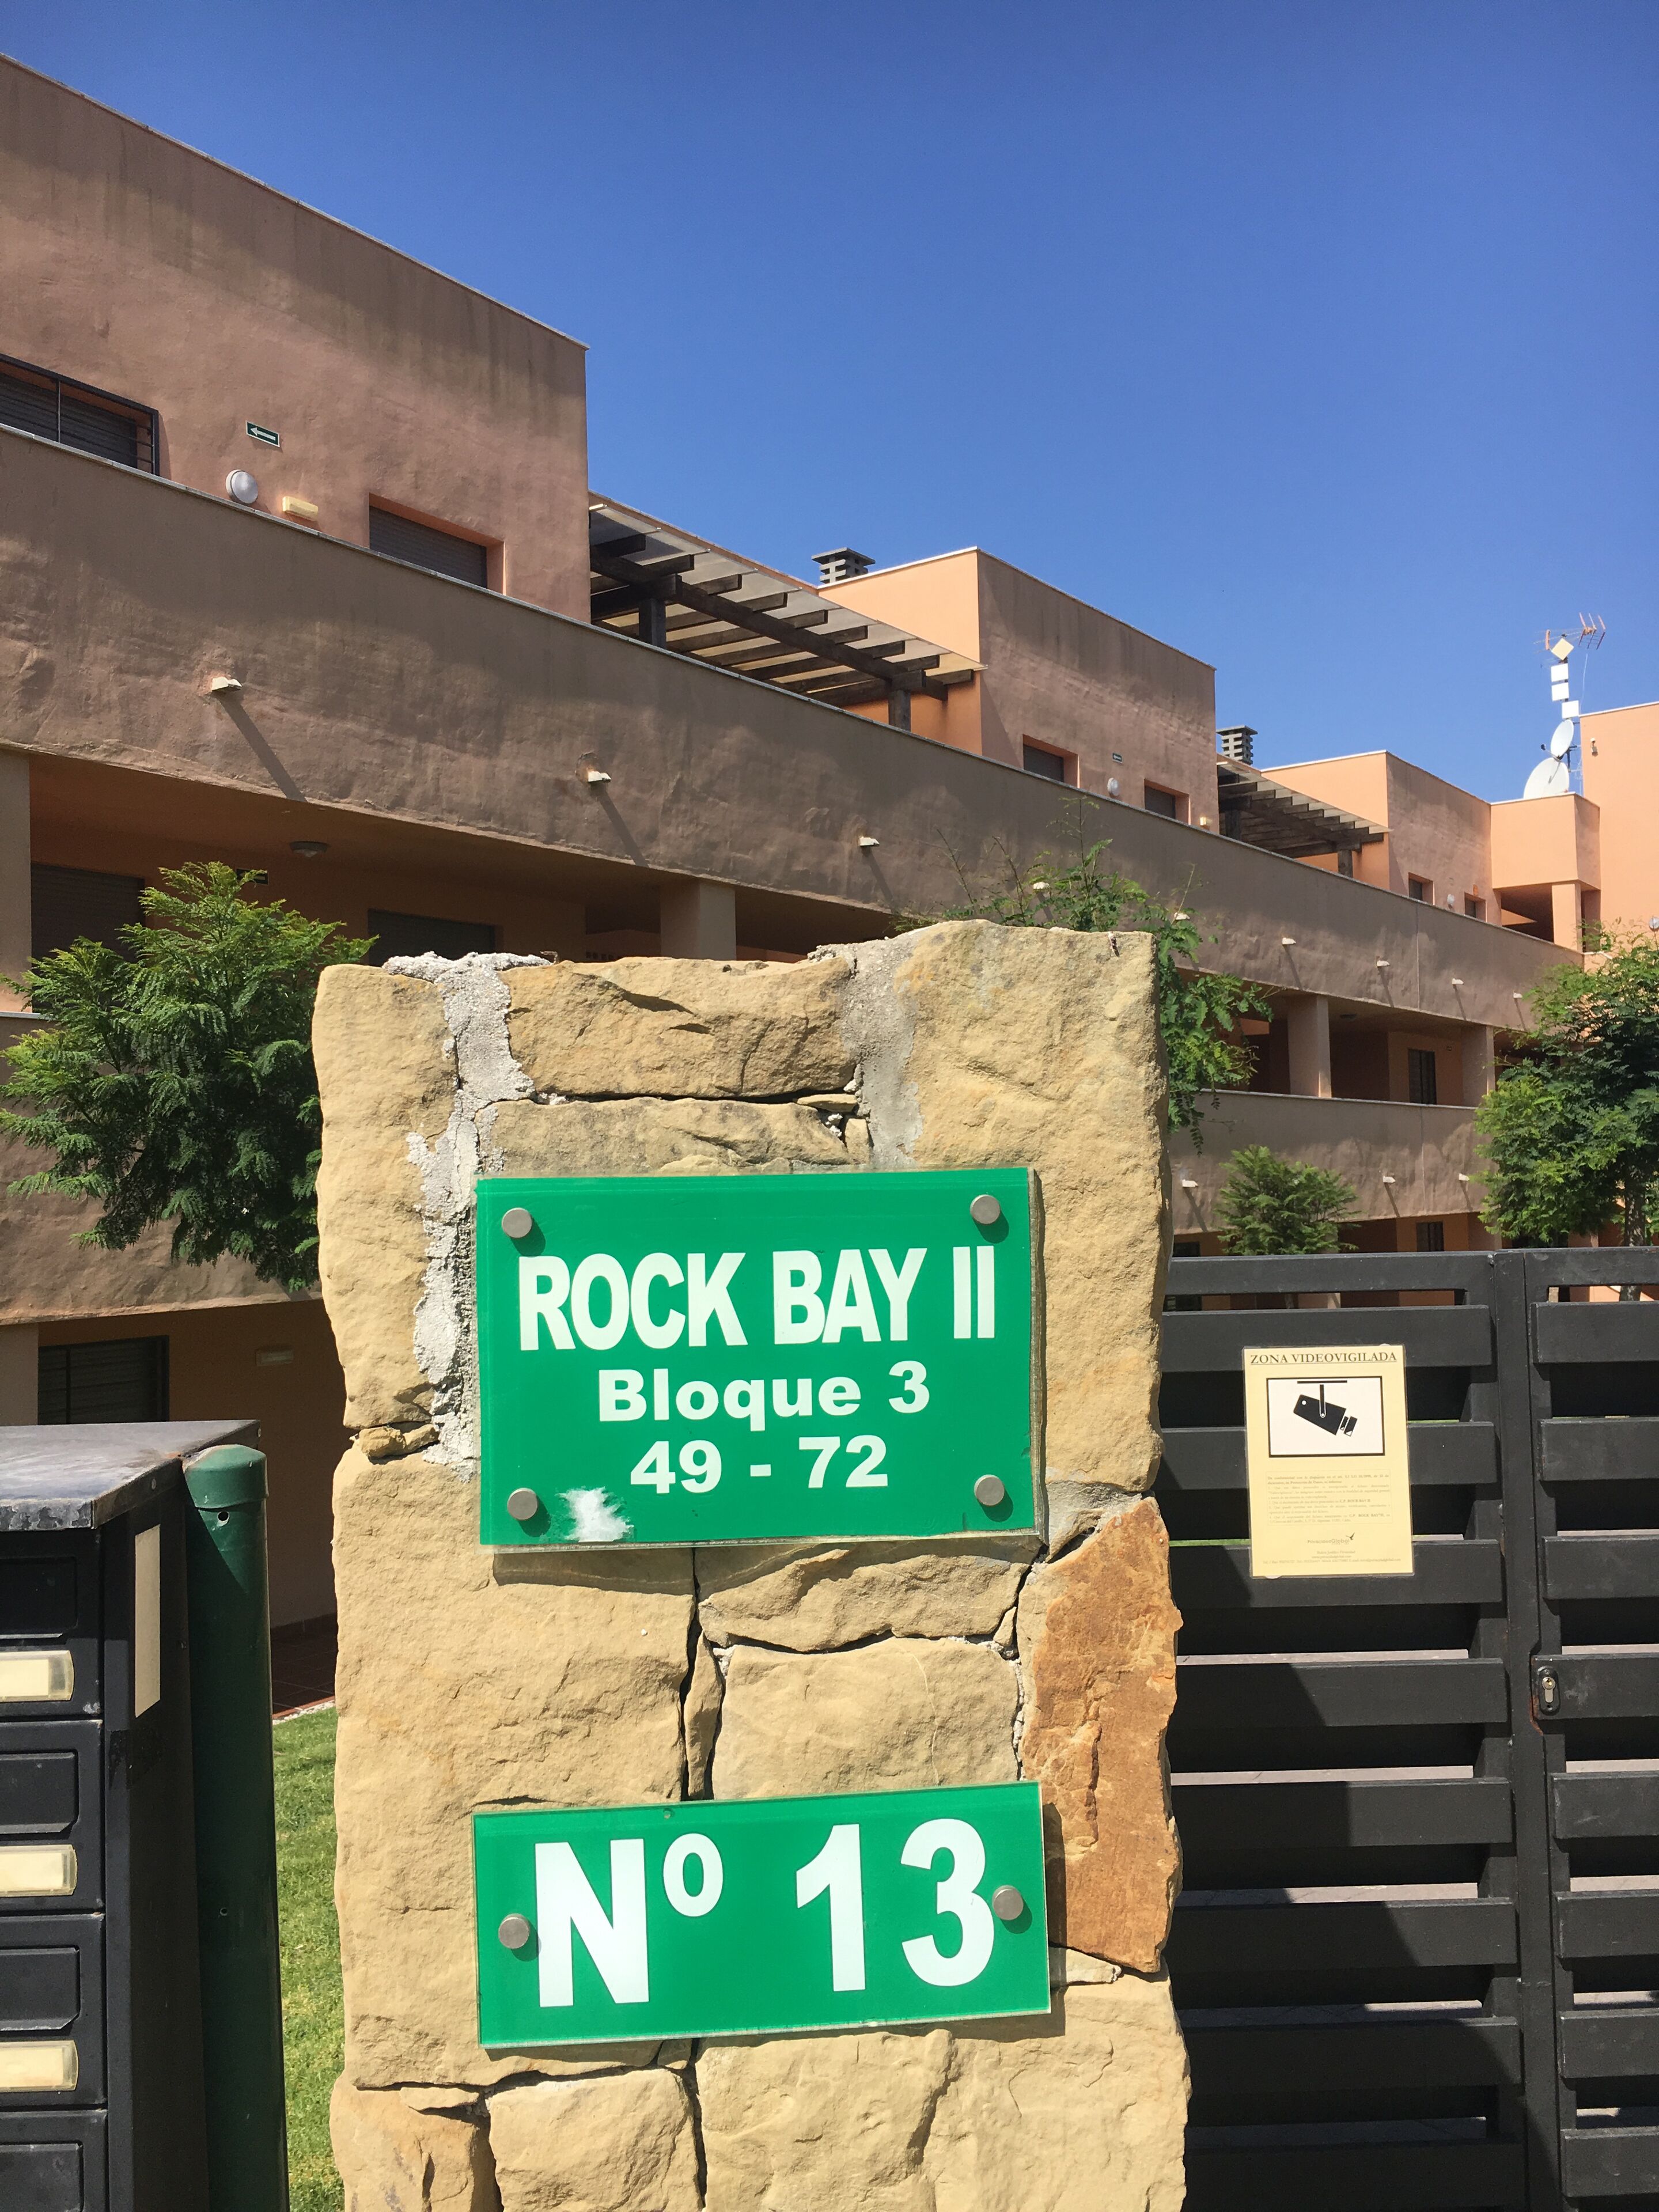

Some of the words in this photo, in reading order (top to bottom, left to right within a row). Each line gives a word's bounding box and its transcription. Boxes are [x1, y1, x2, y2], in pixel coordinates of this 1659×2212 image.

[518, 1252, 748, 1351] ROCK
[772, 1248, 927, 1344] BAY
[953, 1245, 995, 1339] II
[1250, 1354, 1288, 1364] ZONA
[1291, 1352, 1397, 1363] VIDEOVIGILADA
[599, 1368, 861, 1431] Bloque
[888, 1361, 930, 1414] 3
[630, 1440, 722, 1494] 49
[750, 1464, 771, 1477] -
[799, 1435, 888, 1488] 72
[796, 1818, 995, 1992] 13
